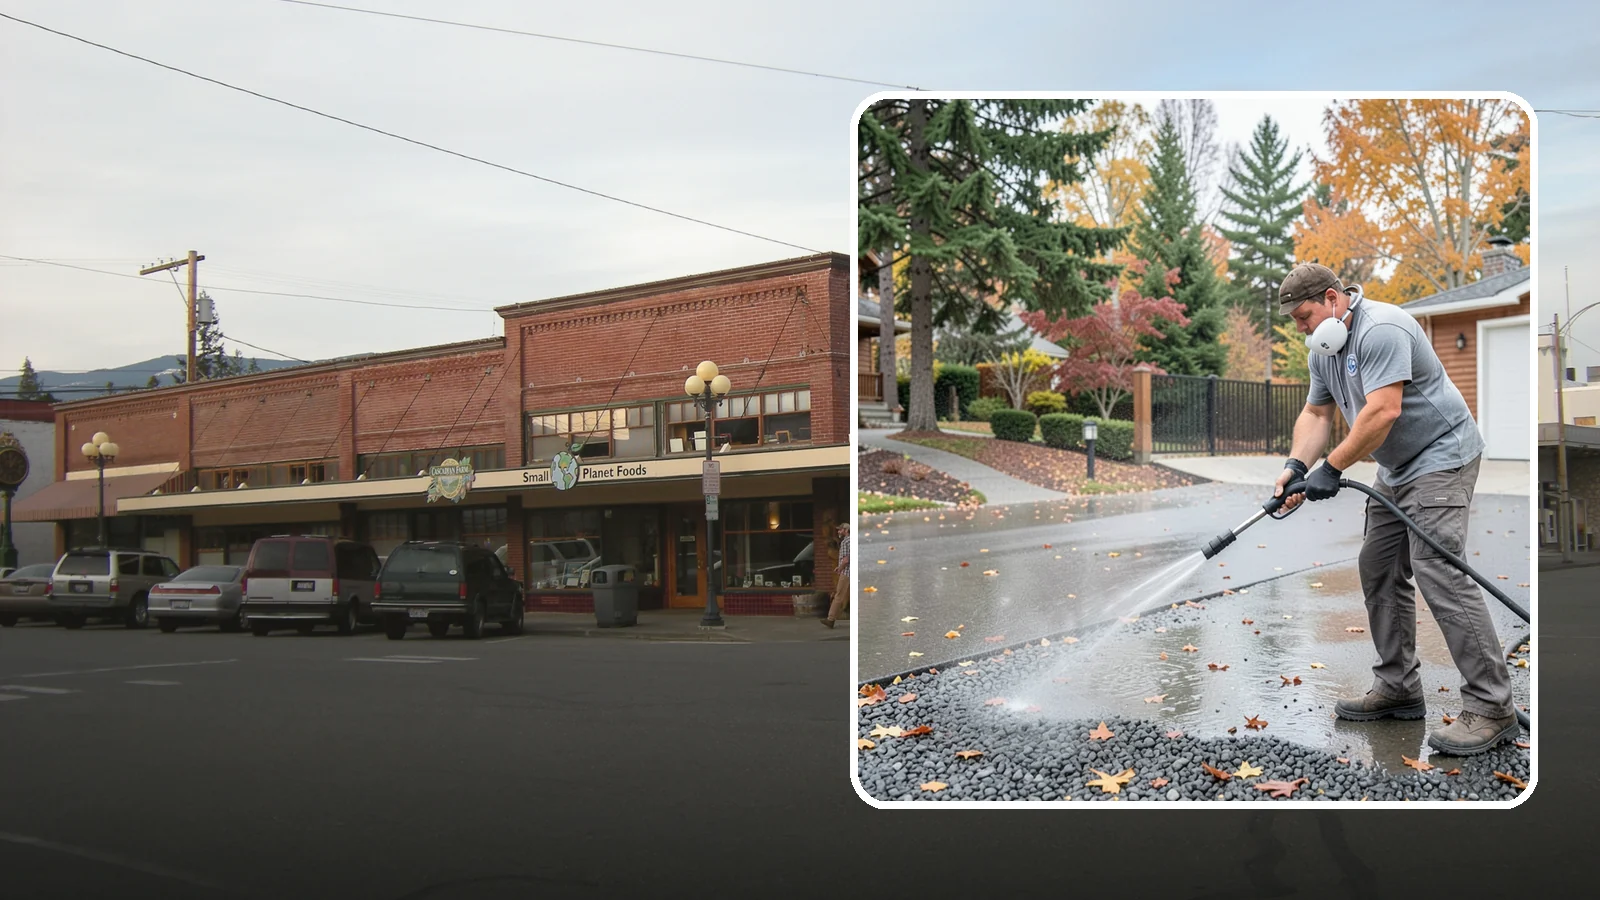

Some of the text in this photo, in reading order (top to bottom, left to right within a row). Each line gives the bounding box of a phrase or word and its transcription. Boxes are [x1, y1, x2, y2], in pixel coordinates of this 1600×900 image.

[431, 465, 469, 476] CASCADIAN FARM
[523, 464, 647, 483] Small Planet Foods
